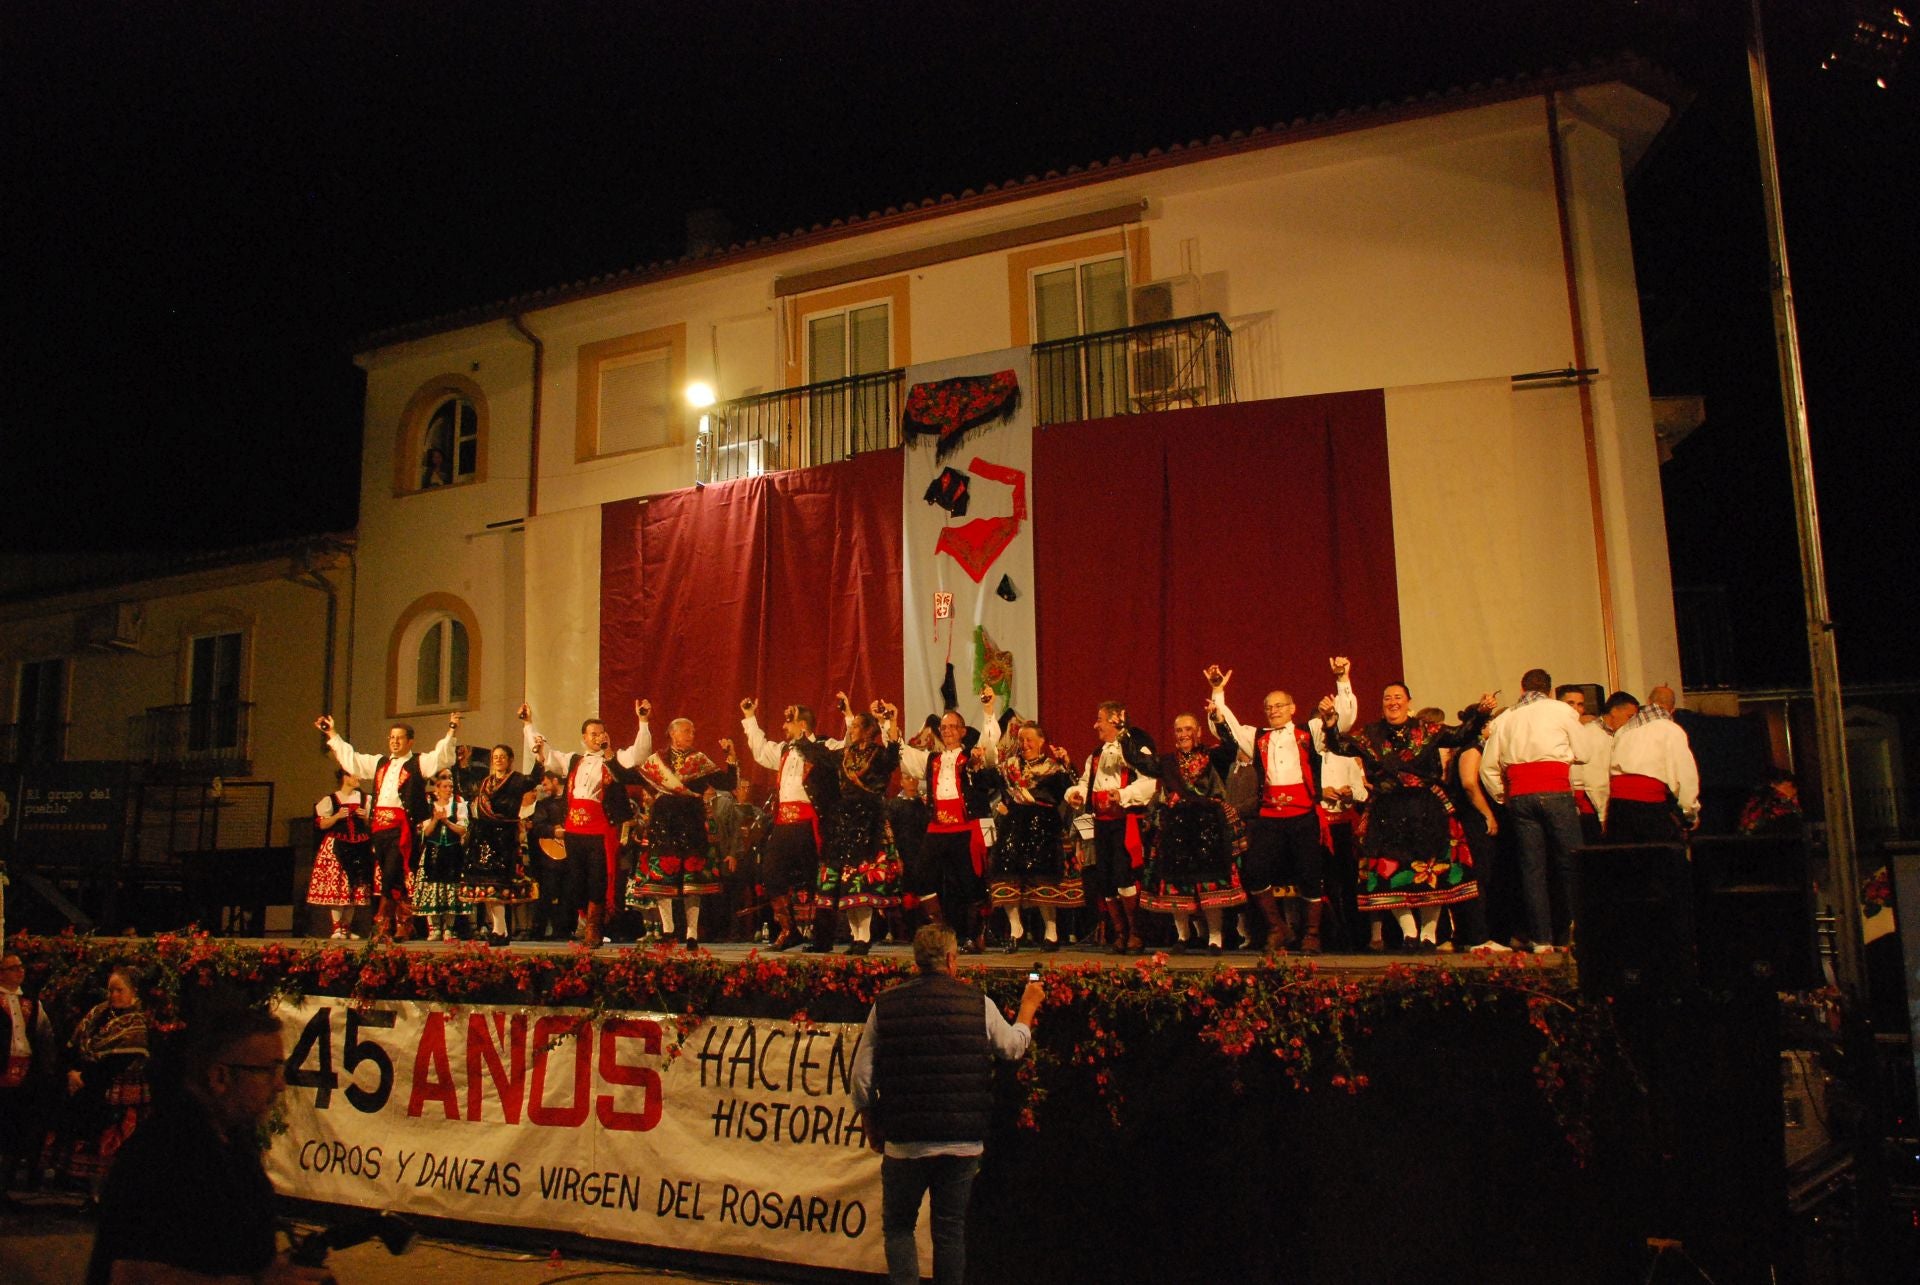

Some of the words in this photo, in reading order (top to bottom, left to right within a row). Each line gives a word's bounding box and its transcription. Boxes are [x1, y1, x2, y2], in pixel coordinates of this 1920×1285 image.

[89, 788, 112, 799] del
[285, 1006, 396, 1114] 45
[712, 1099, 866, 1149] HISTORIA
[300, 1139, 382, 1179] COROS
[396, 1150, 416, 1184] Y
[415, 1152, 522, 1197] DANZAS
[540, 1165, 640, 1213] VIRGEN
[658, 1178, 704, 1221] DEL
[720, 1183, 867, 1239] ROSARIO
